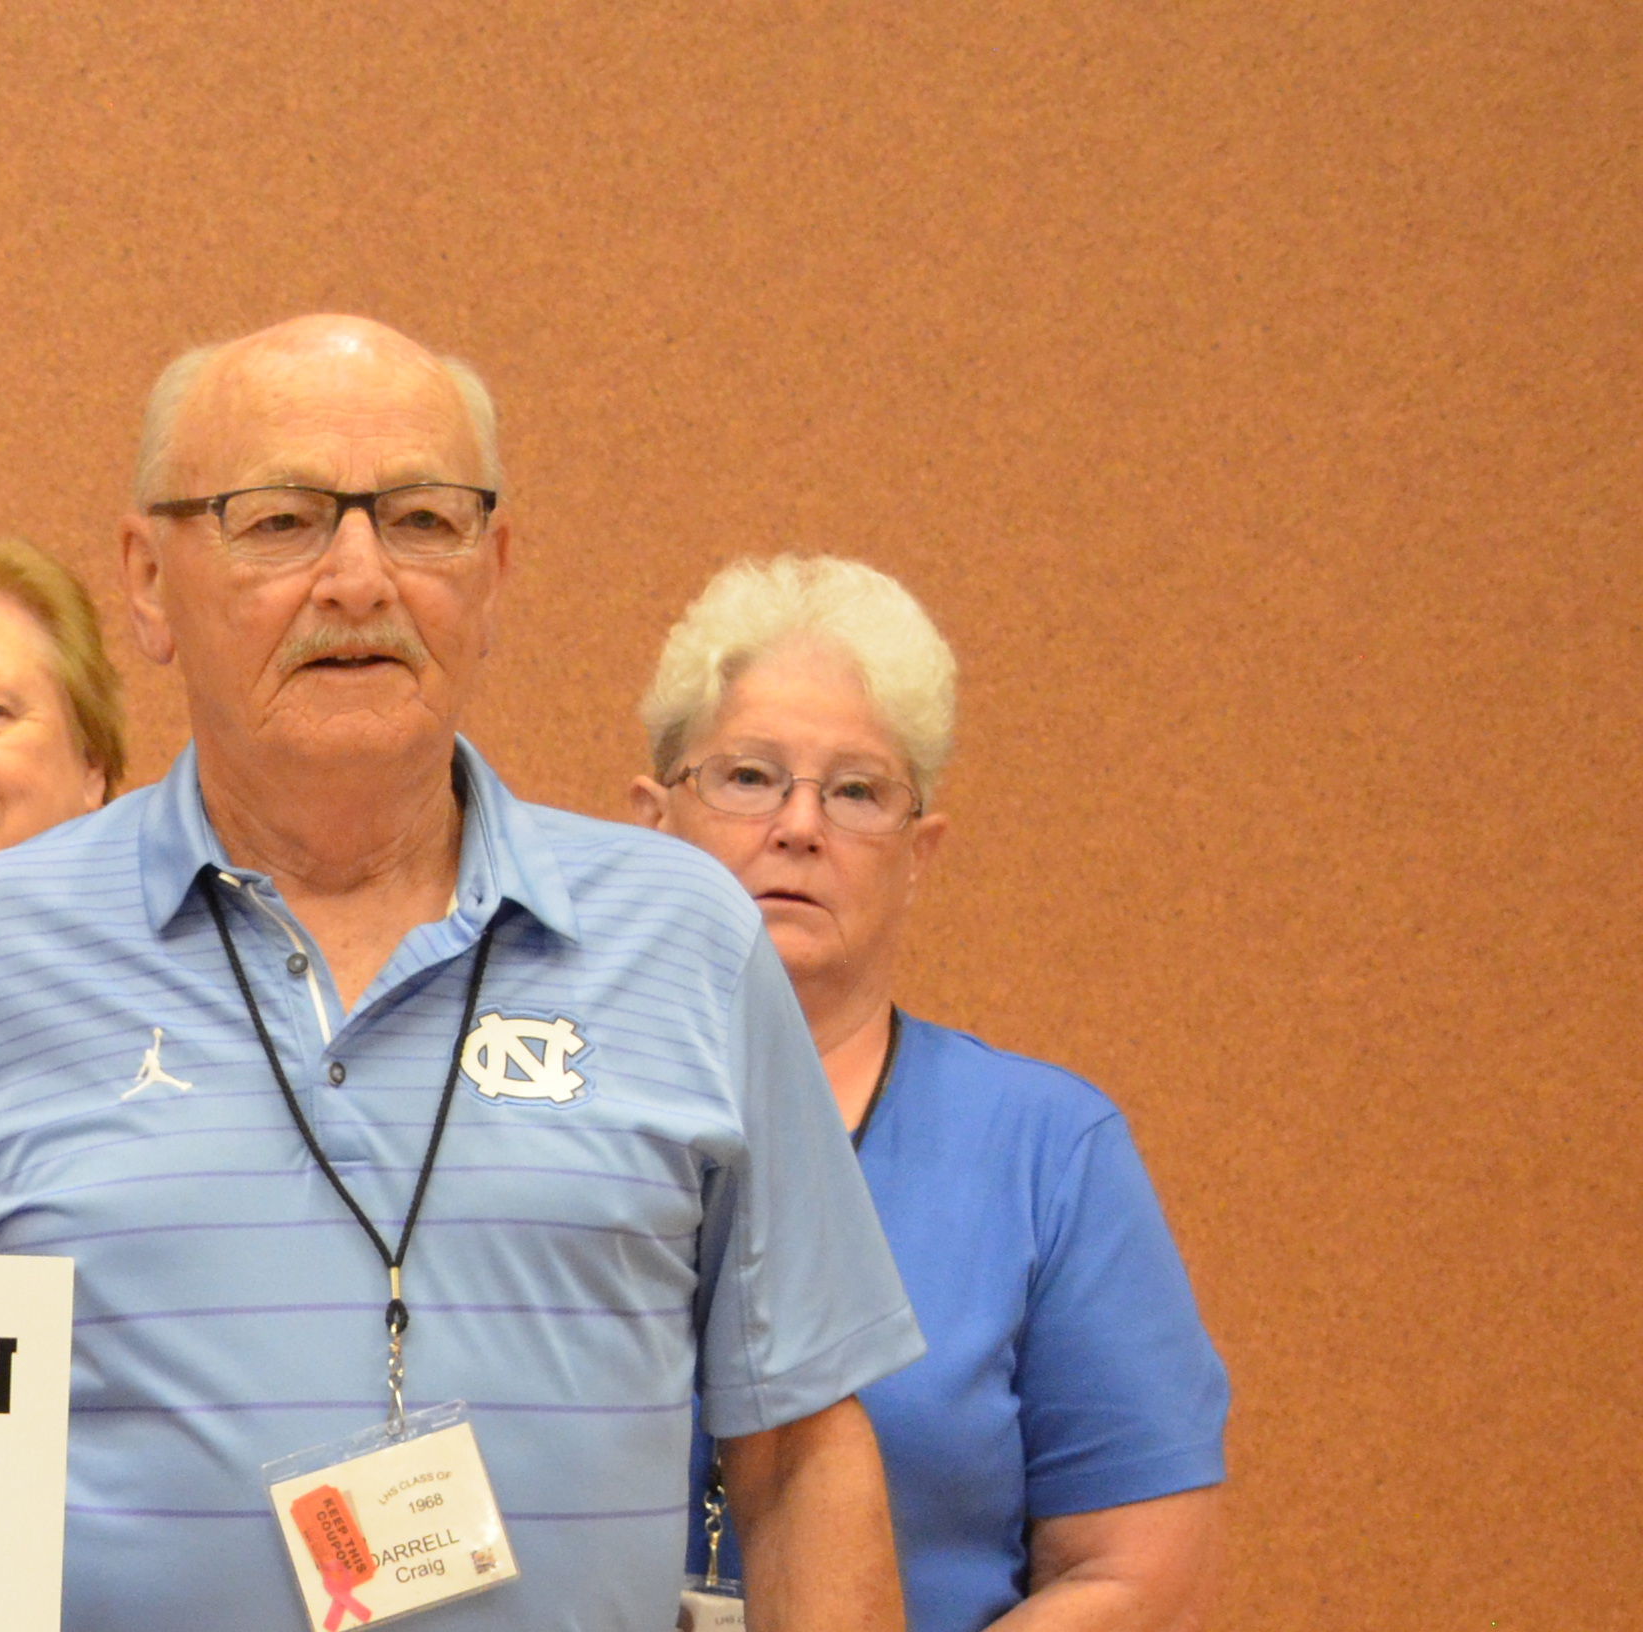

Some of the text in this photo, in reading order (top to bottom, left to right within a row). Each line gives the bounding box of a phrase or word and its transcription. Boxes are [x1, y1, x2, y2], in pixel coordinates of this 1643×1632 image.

[378, 1470, 453, 1506] LHS CLASS OF
[408, 1493, 444, 1514] 1968
[316, 1511, 352, 1570] COUPON
[323, 1498, 367, 1574] KEEP THIS
[395, 1557, 445, 1583] Craig
